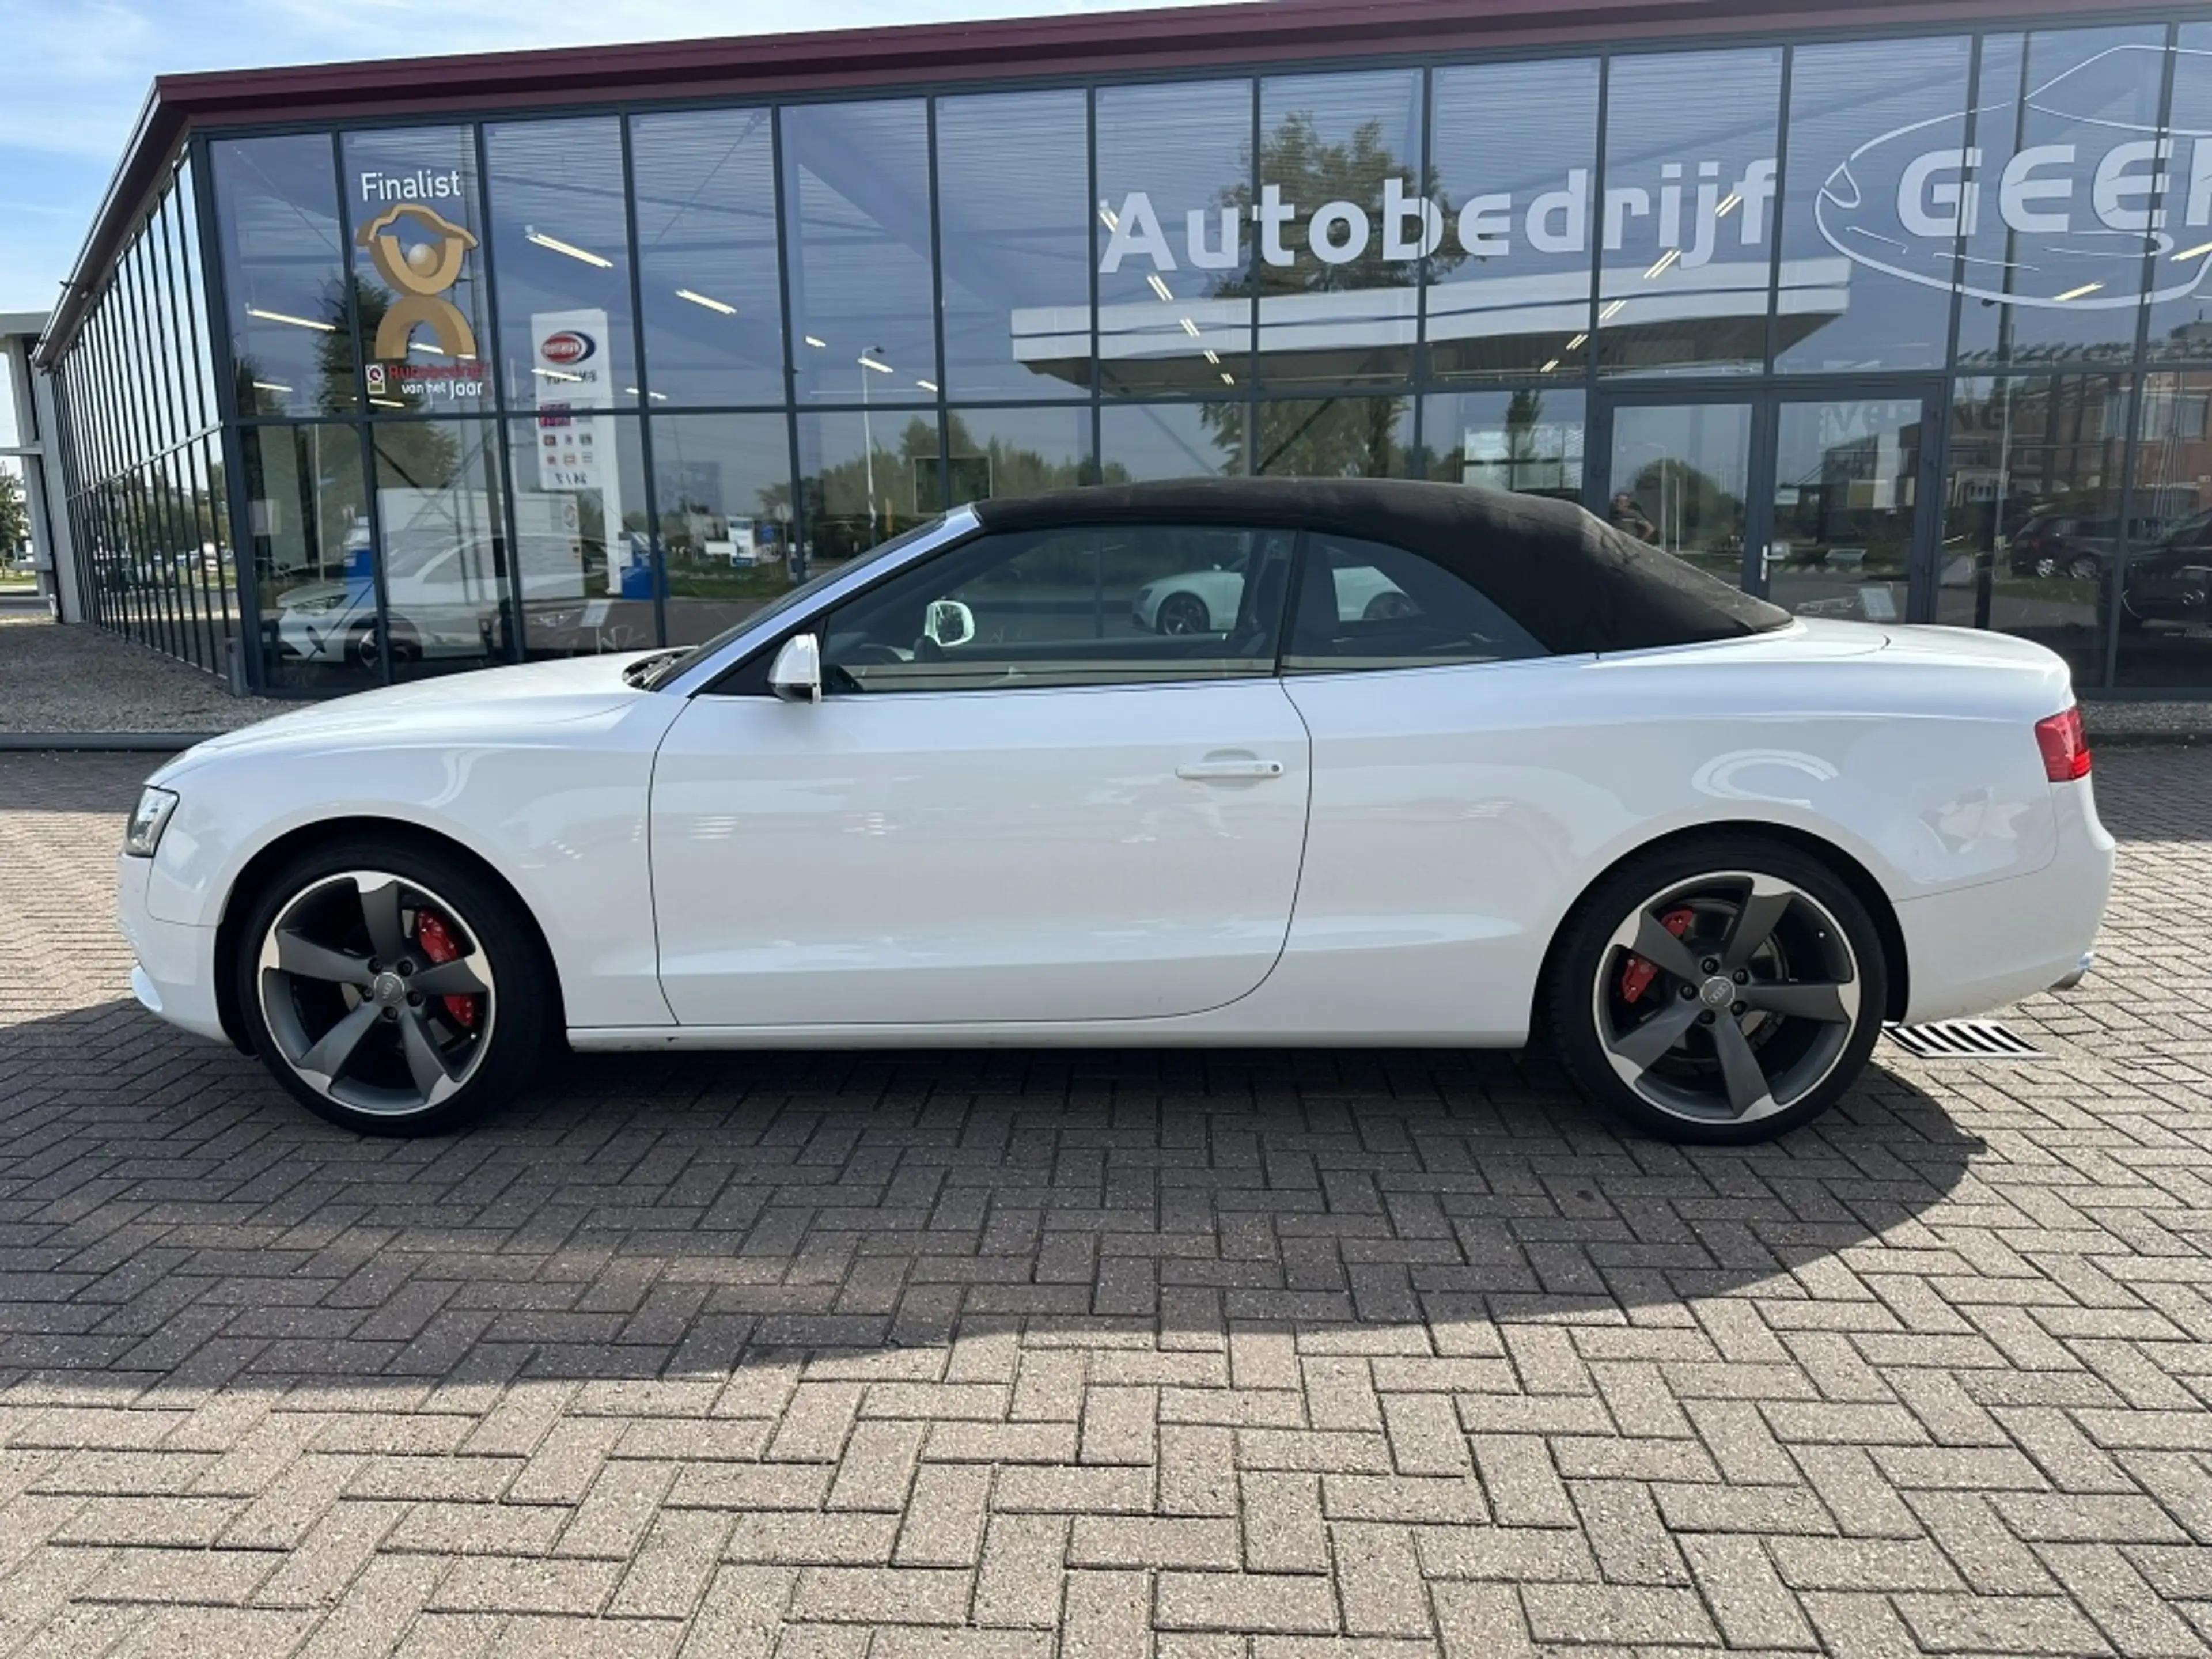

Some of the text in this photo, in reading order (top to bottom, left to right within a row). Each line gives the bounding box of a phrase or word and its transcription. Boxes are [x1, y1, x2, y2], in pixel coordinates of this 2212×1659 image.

[361, 169, 461, 202] Finalist
[1098, 160, 1776, 273] Autobedrijf
[401, 383, 425, 395] van
